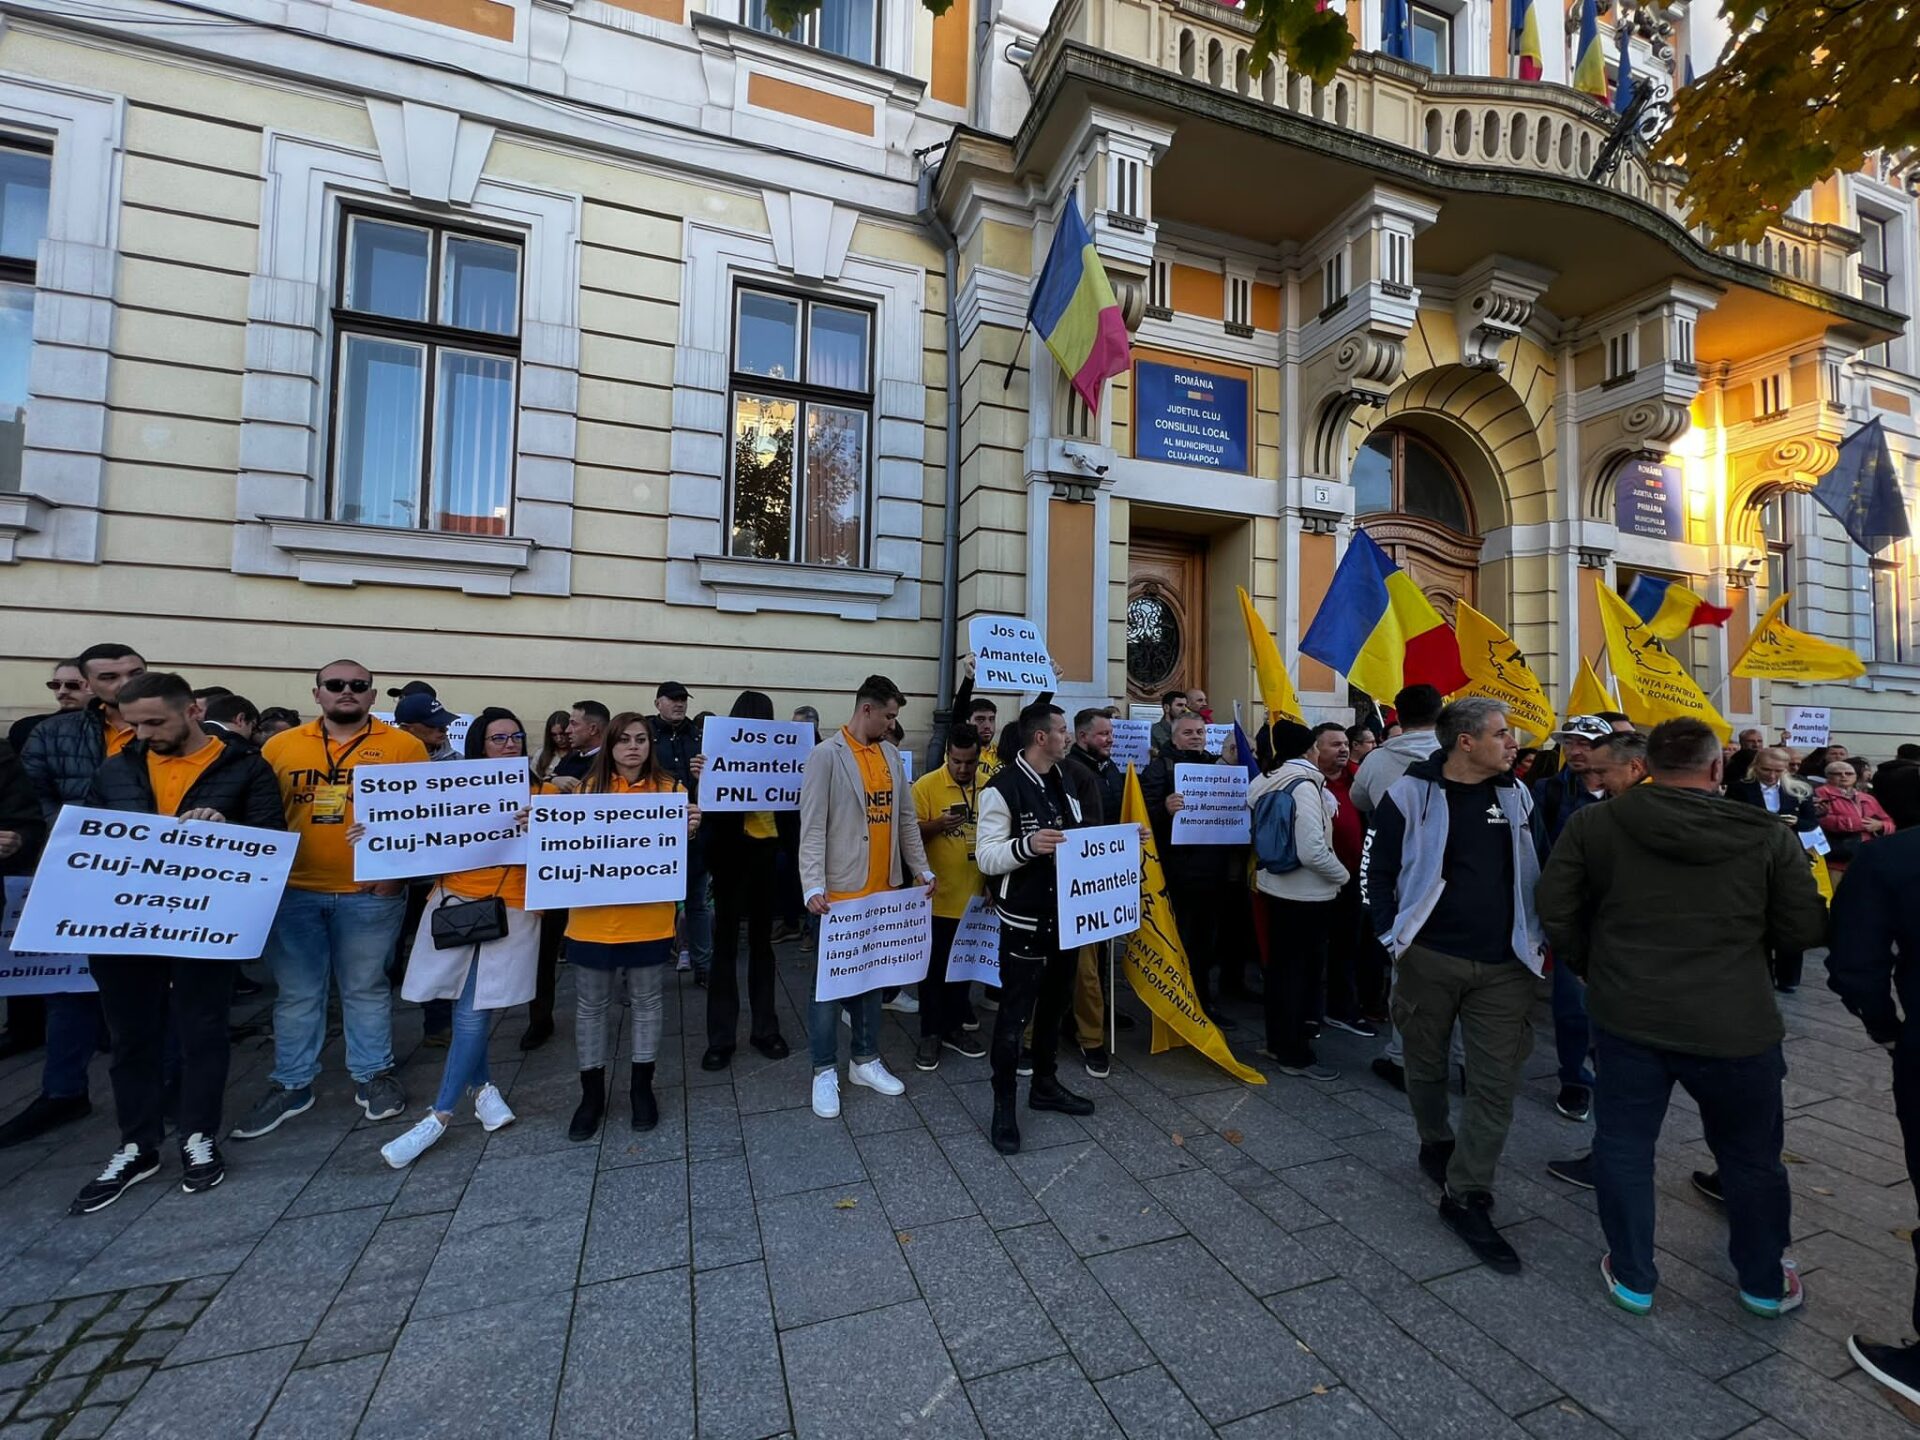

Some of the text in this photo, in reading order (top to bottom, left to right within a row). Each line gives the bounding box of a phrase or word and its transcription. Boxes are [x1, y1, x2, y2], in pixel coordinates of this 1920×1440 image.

[1174, 375, 1213, 389] ROMÂNIA
[1202, 411, 1220, 421] CLUJ
[1155, 419, 1230, 440] CONSILIUL LOCAL
[1163, 437, 1223, 453] AL MUNICIPIULUI
[1167, 450, 1219, 465] CLUJ-NAPOCA
[990, 624, 1035, 640] Jos cu
[1759, 629, 1781, 646] UR
[980, 647, 1046, 664] Amantele
[987, 670, 1048, 687] PNL Cluj
[1800, 711, 1812, 719] Jos
[1792, 723, 1829, 731] Amantele
[731, 728, 797, 745] Jos cu
[1810, 736, 1825, 745] Cluj
[360, 770, 525, 794] Stop speculei
[1182, 774, 1203, 783] Avem
[1233, 776, 1241, 784] de
[716, 787, 801, 805] PNL Cluj
[368, 799, 519, 823] imobiliare în
[535, 805, 683, 825] Stop speculei
[1201, 802, 1247, 812] Monumentul
[79, 819, 278, 857] BOC distruge
[368, 825, 522, 852] Cluj-Napoca!
[541, 833, 676, 851] imobiliare în
[1081, 839, 1125, 858] Jos cu
[67, 852, 252, 884] Cluj-Napoca
[538, 861, 678, 883] Cluj-Napoca!
[1070, 869, 1137, 898] Amantele
[114, 893, 210, 913] orașul
[829, 913, 862, 925] Avem
[865, 904, 901, 919] dreptul
[905, 902, 917, 911] de
[1076, 902, 1137, 934] PNL Cluj
[55, 920, 240, 945] fundăturilor
[827, 918, 927, 943] strânge semnături
[826, 933, 927, 961] lângă Monumentul
[981, 941, 994, 949] ne
[830, 950, 923, 978] Memorandiștilor!
[952, 954, 963, 963] din
